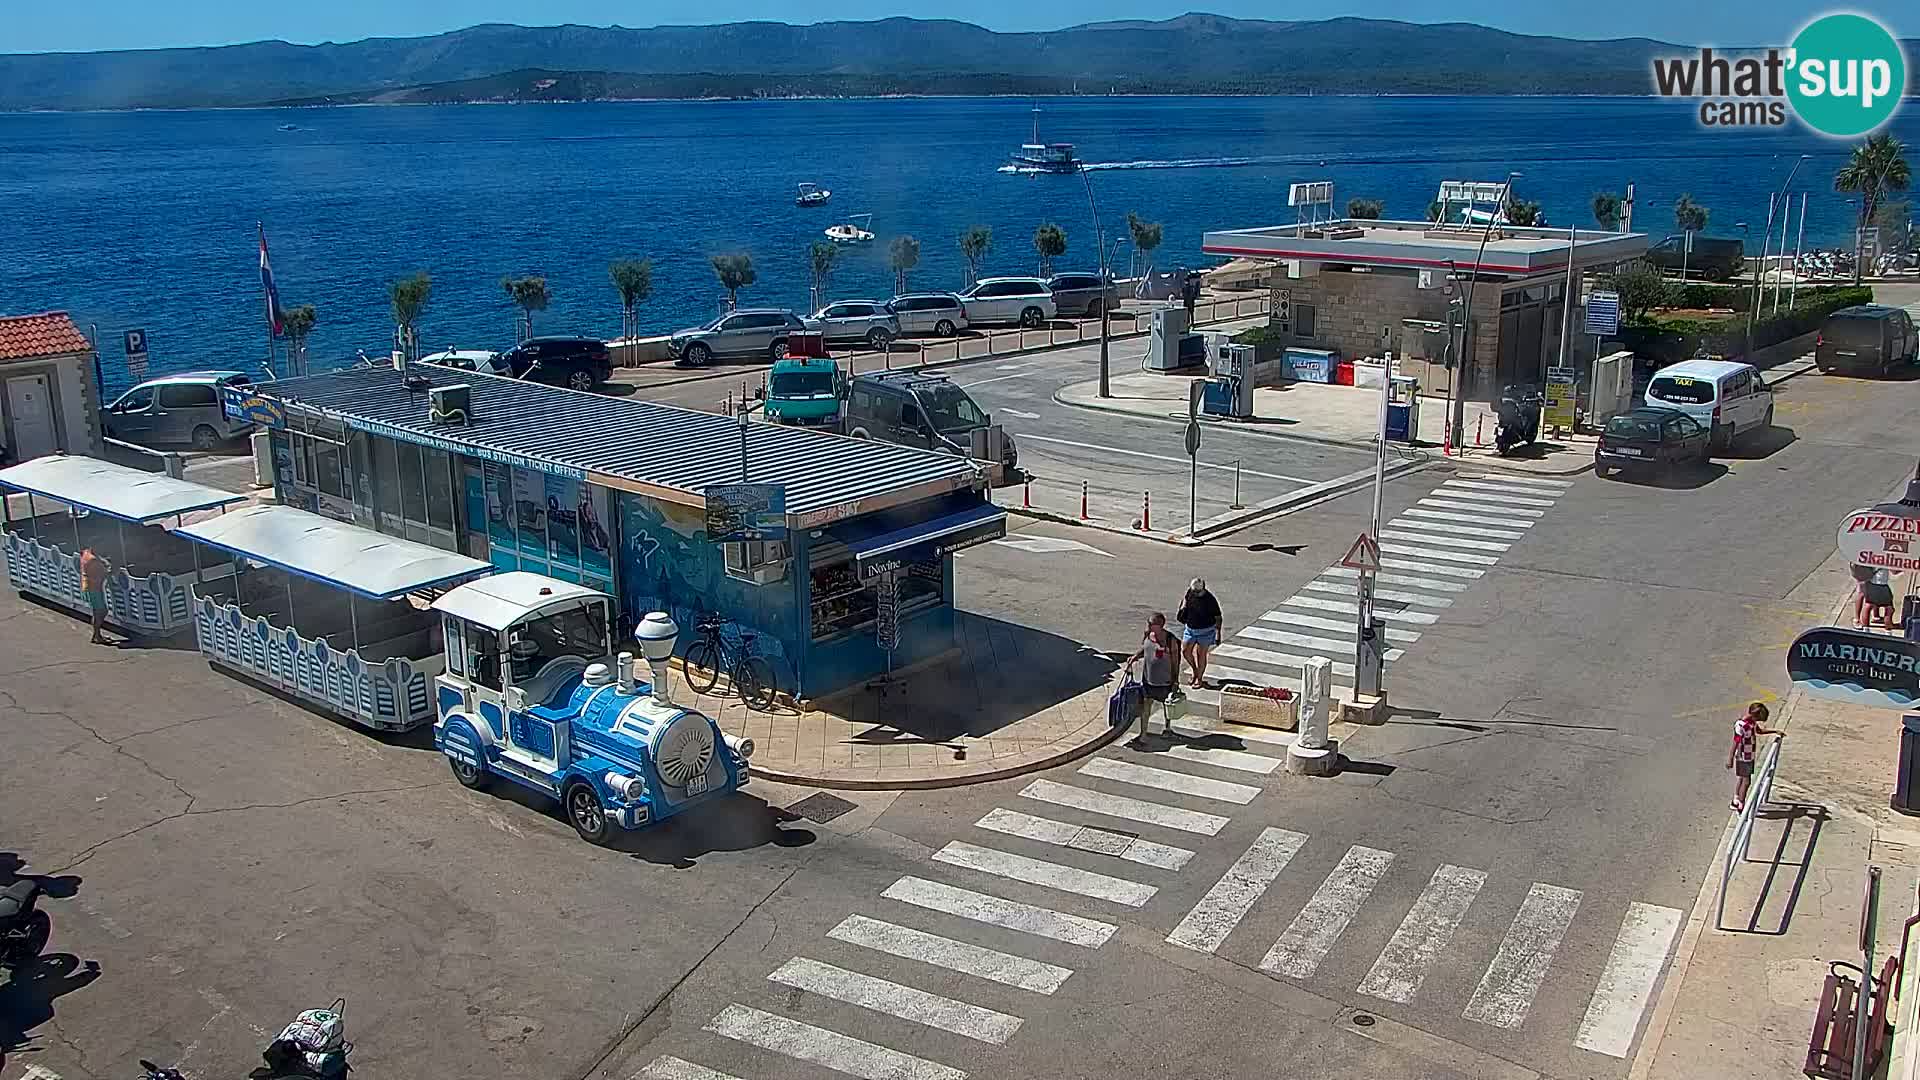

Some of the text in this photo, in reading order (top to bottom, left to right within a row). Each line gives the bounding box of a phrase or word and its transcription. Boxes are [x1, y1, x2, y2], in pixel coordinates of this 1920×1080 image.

[128, 333, 141, 351] P
[1674, 378, 1694, 387] TAXI
[477, 448, 491, 459] BUS
[493, 450, 525, 467] STATION
[528, 459, 553, 473] TICKET
[554, 465, 581, 479] OFFICE
[1846, 516, 1920, 535] PIZZE
[1881, 531, 1916, 542] GRILL
[1828, 662, 1896, 681] caffe bar
